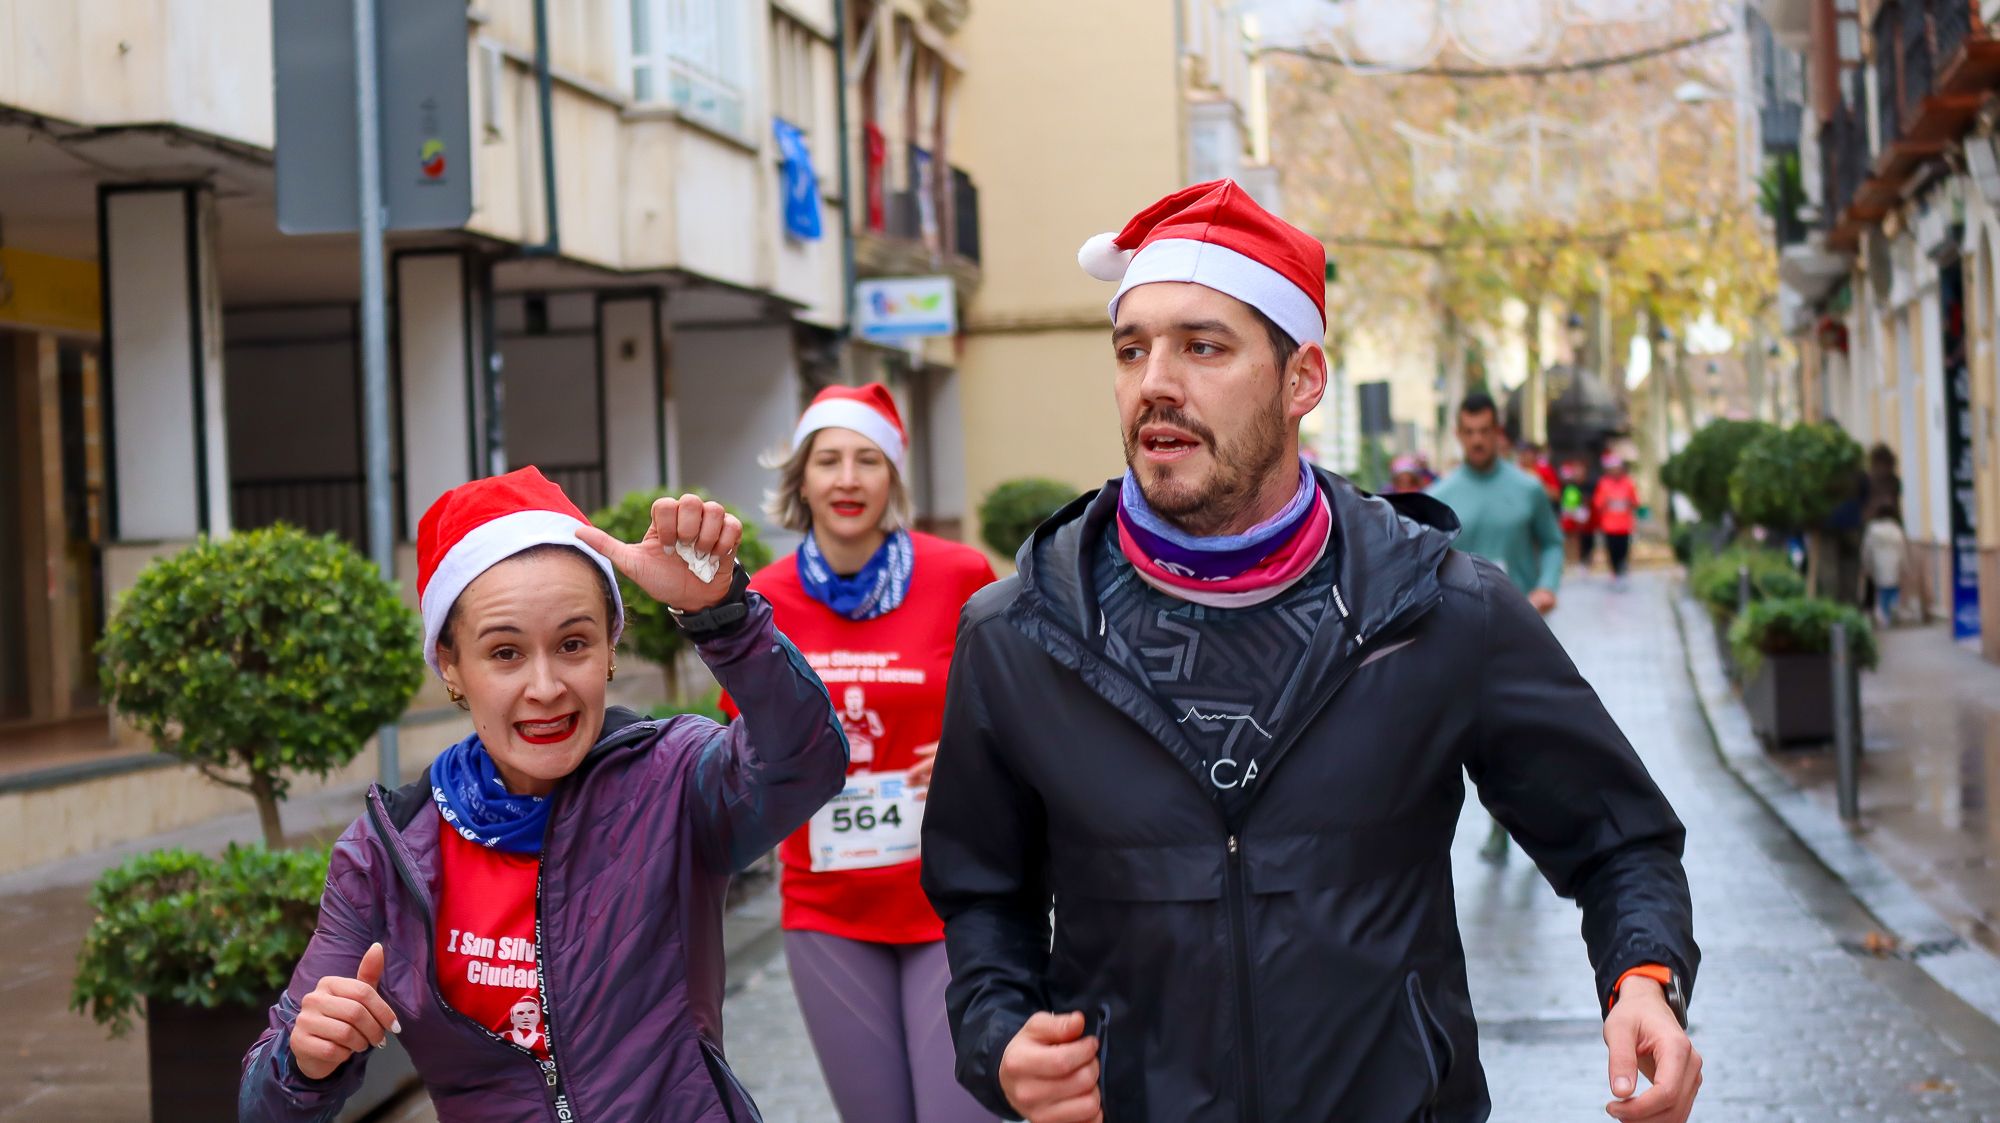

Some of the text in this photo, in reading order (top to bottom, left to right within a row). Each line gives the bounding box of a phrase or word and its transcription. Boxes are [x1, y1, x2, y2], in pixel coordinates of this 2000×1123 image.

[832, 803, 903, 833] 564
[447, 929, 460, 953] I
[460, 931, 496, 959] San
